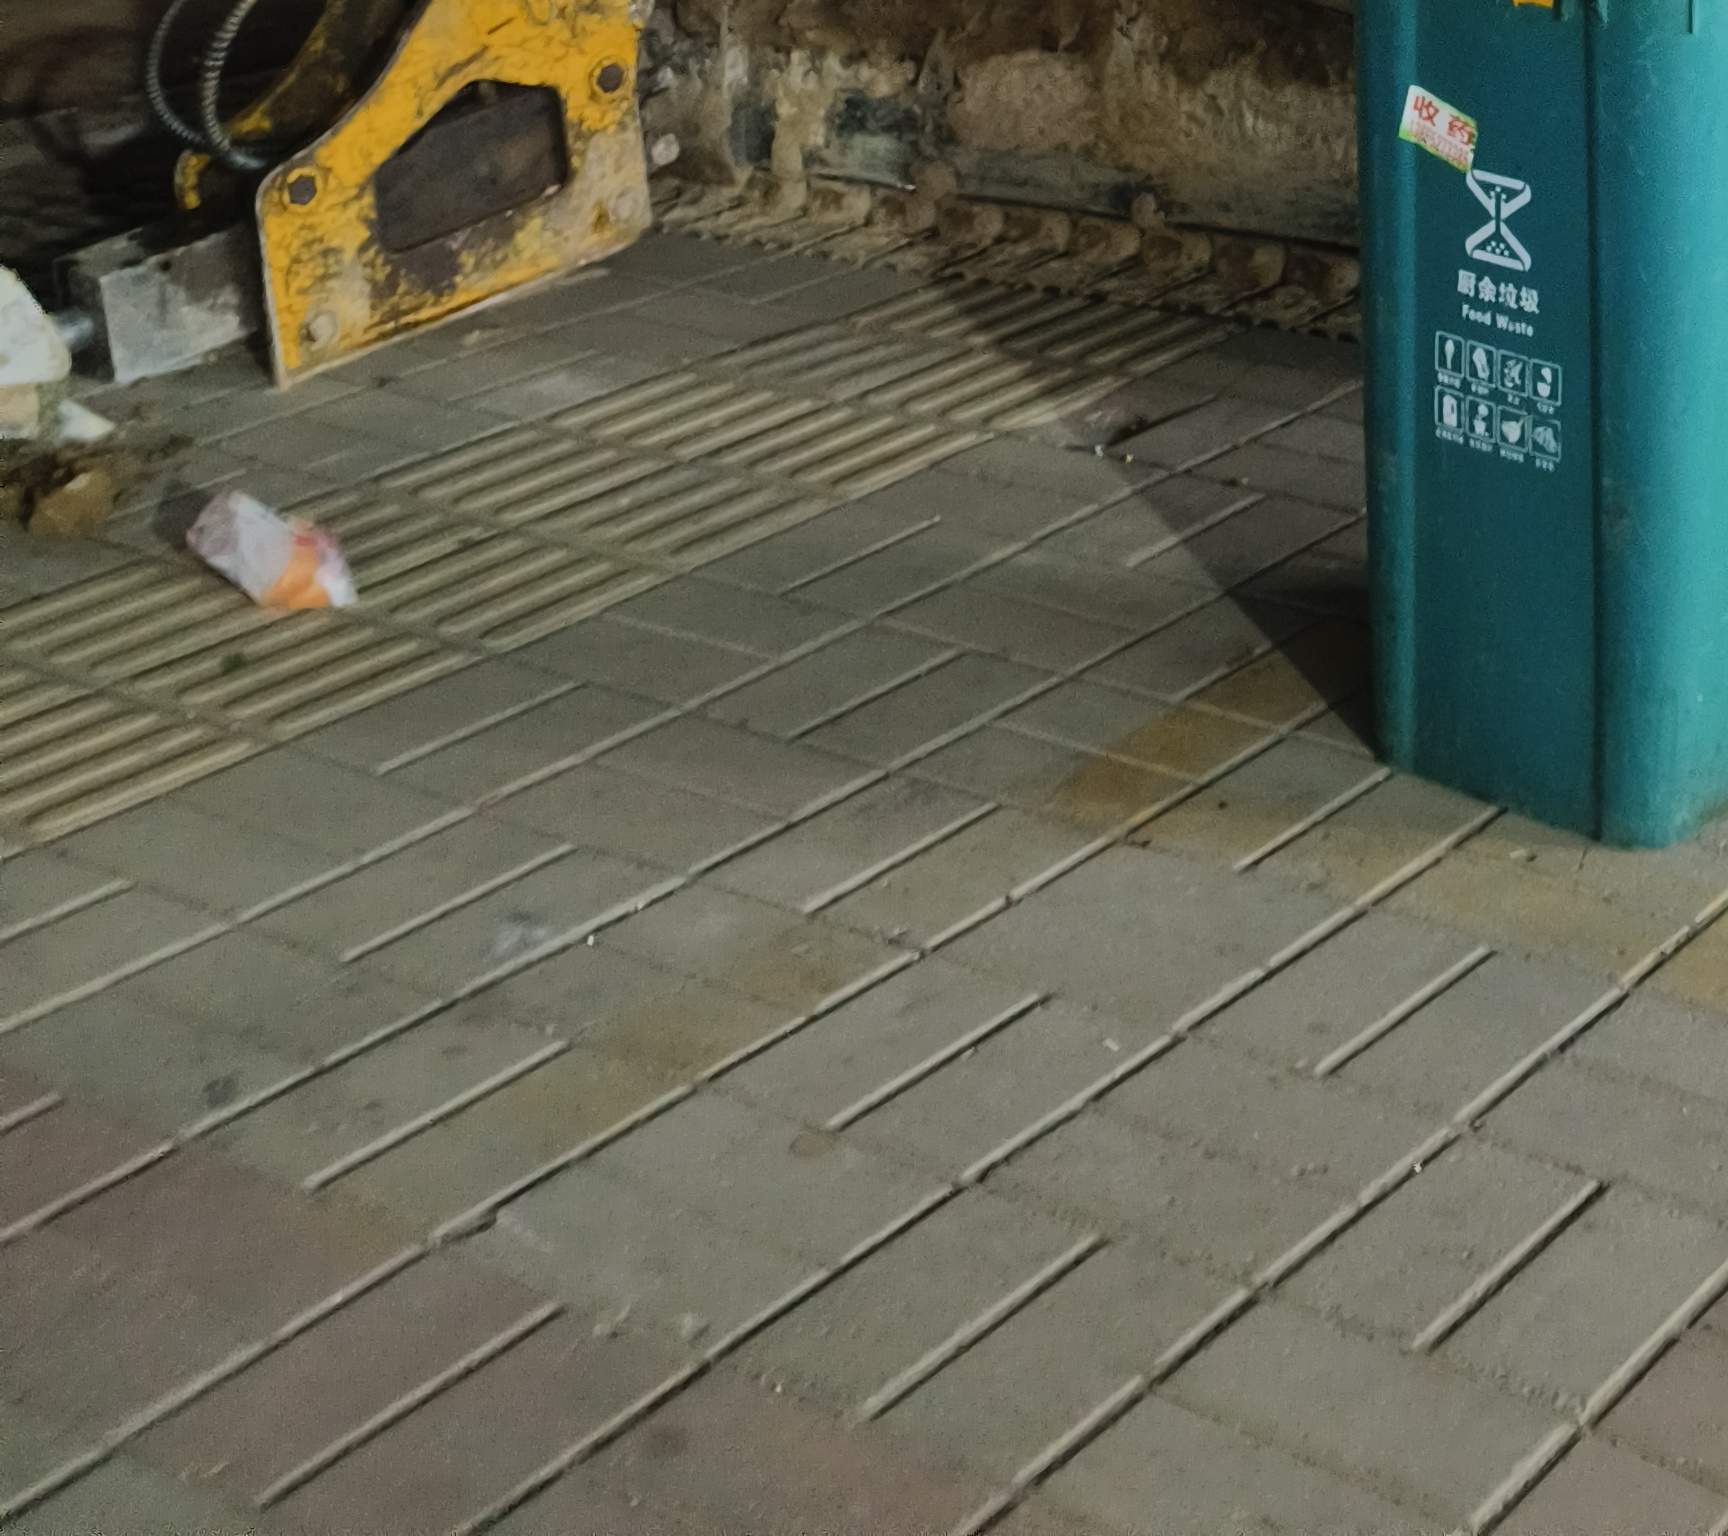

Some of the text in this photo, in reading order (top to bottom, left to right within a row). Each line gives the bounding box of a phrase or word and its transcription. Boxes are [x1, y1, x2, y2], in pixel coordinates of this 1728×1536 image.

[1457, 268, 1540, 314] 厨余垃圾
[1462, 303, 1492, 326] Food
